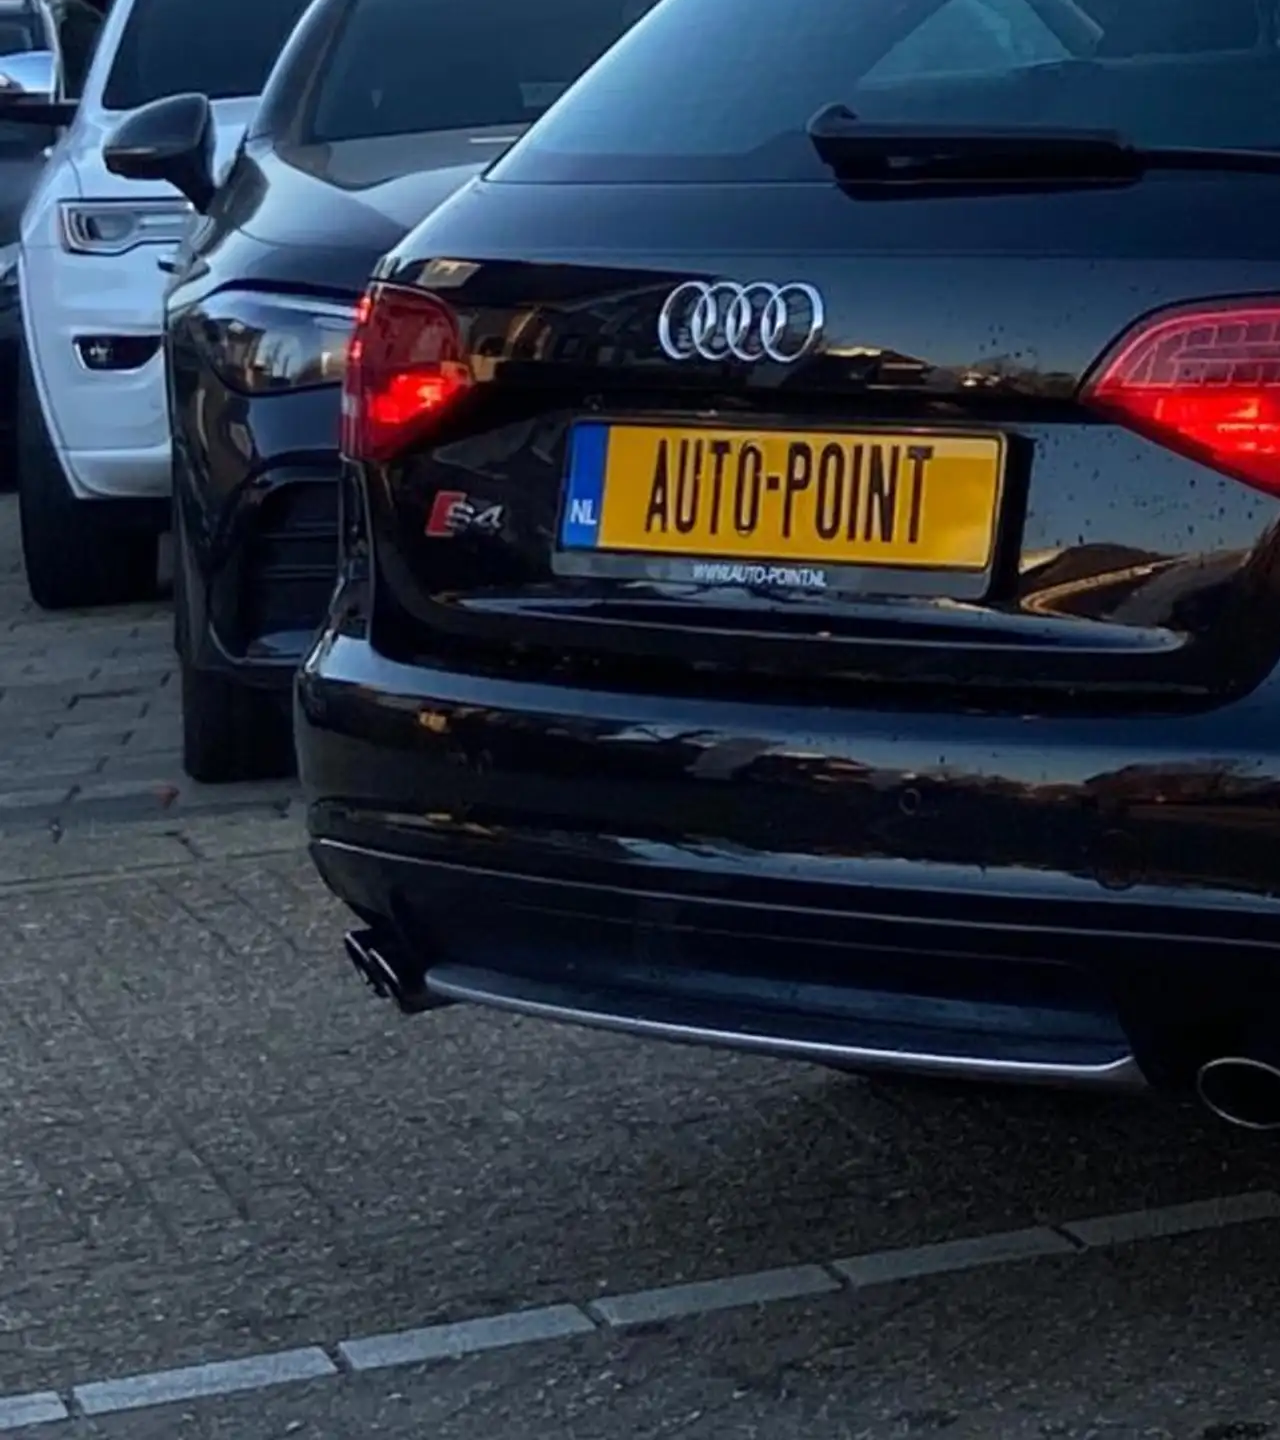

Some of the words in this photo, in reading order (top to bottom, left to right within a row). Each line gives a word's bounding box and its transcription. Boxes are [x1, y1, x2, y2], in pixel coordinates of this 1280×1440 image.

[644, 438, 934, 544] AUTO-POINT
[442, 499, 504, 533] S4
[570, 498, 597, 526] NL
